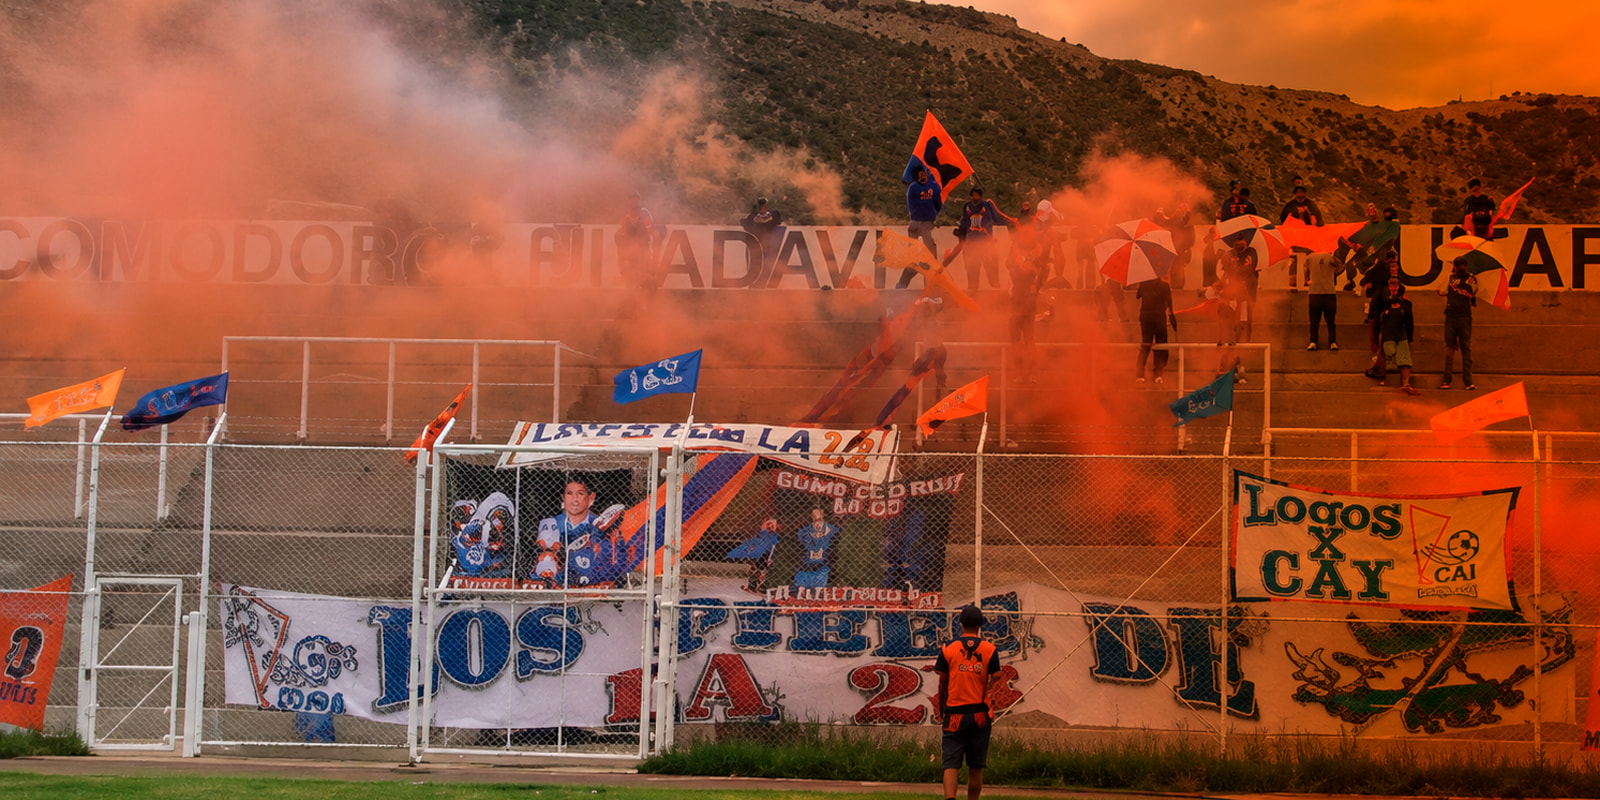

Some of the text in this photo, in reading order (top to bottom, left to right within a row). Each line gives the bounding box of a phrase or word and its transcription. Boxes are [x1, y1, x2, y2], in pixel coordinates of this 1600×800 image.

[758, 427, 810, 460] LA
[1307, 525, 1346, 562] X
[1260, 549, 1394, 602] CAY
[1434, 563, 1477, 583] CAI
[367, 603, 587, 714] LOS
